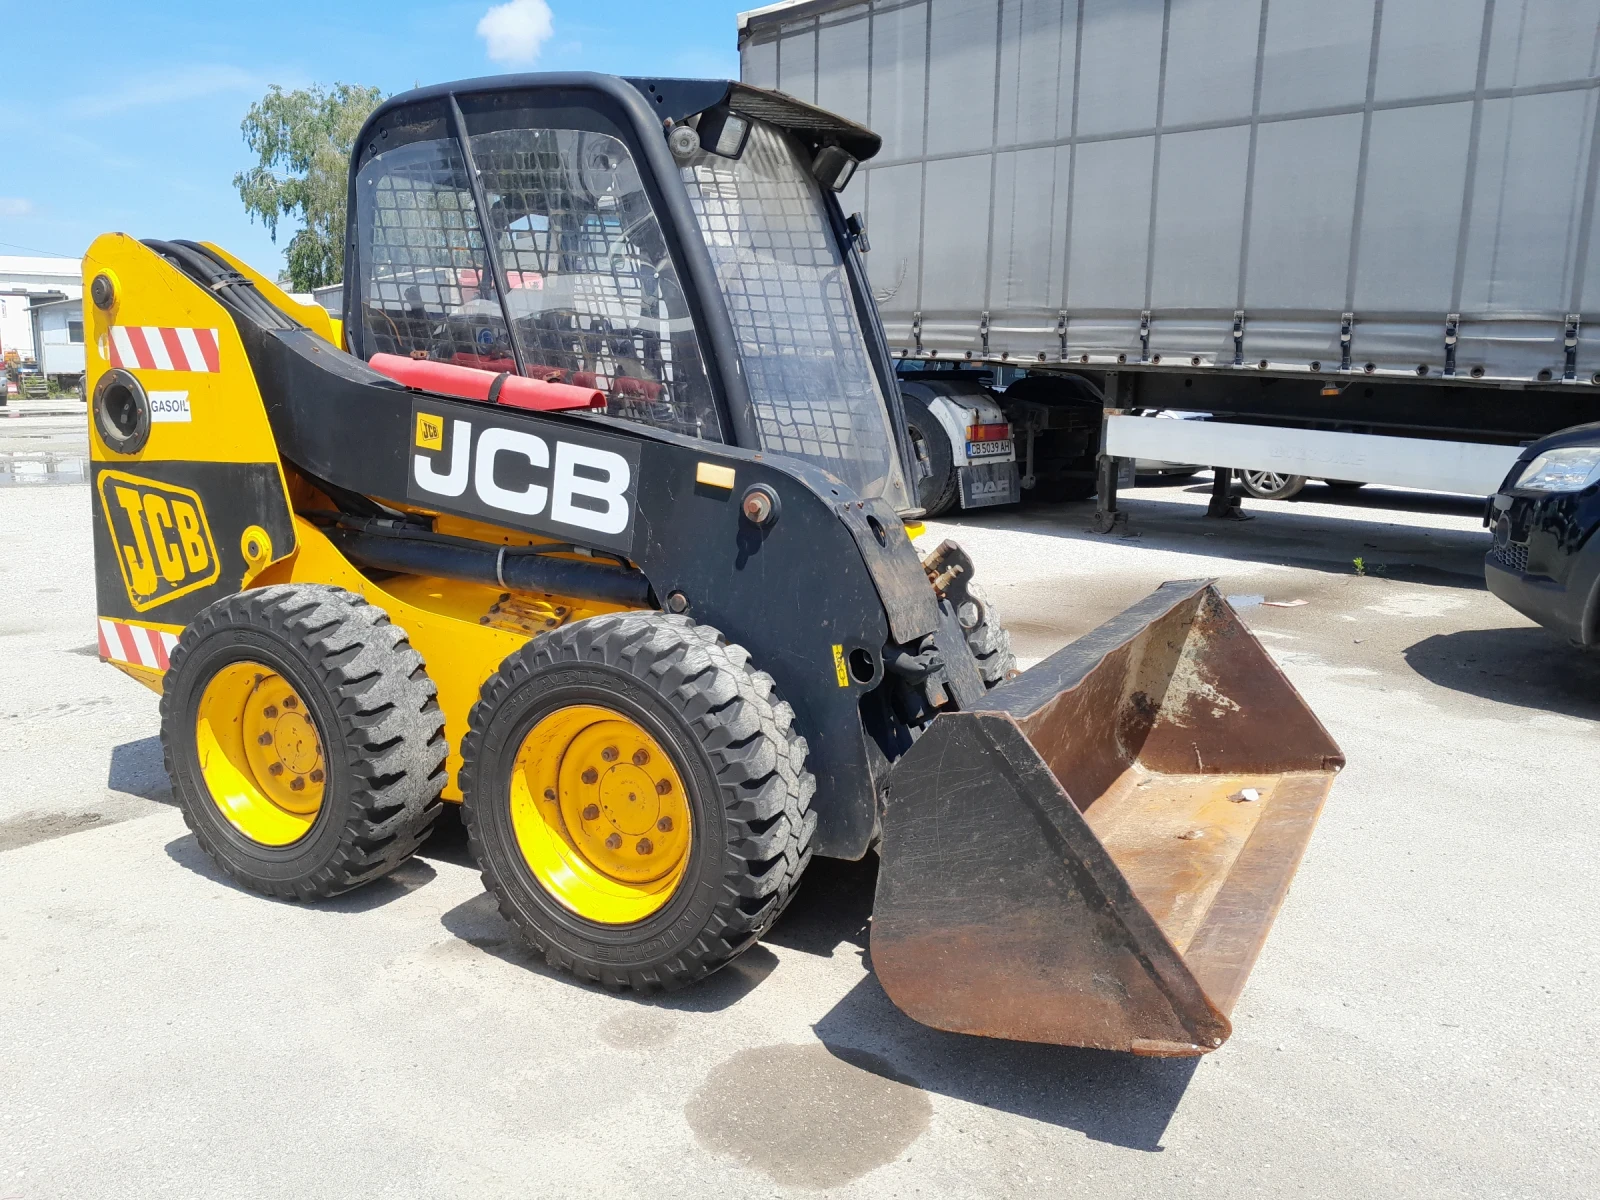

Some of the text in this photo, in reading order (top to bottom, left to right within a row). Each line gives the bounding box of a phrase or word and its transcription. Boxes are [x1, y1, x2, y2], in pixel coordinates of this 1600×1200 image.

[151, 400, 189, 412] GASOIL
[422, 422, 439, 439] JCB
[981, 442, 999, 454] 5039
[414, 419, 631, 535] JCB
[971, 480, 1010, 494] DAF
[114, 485, 209, 596] JCB
